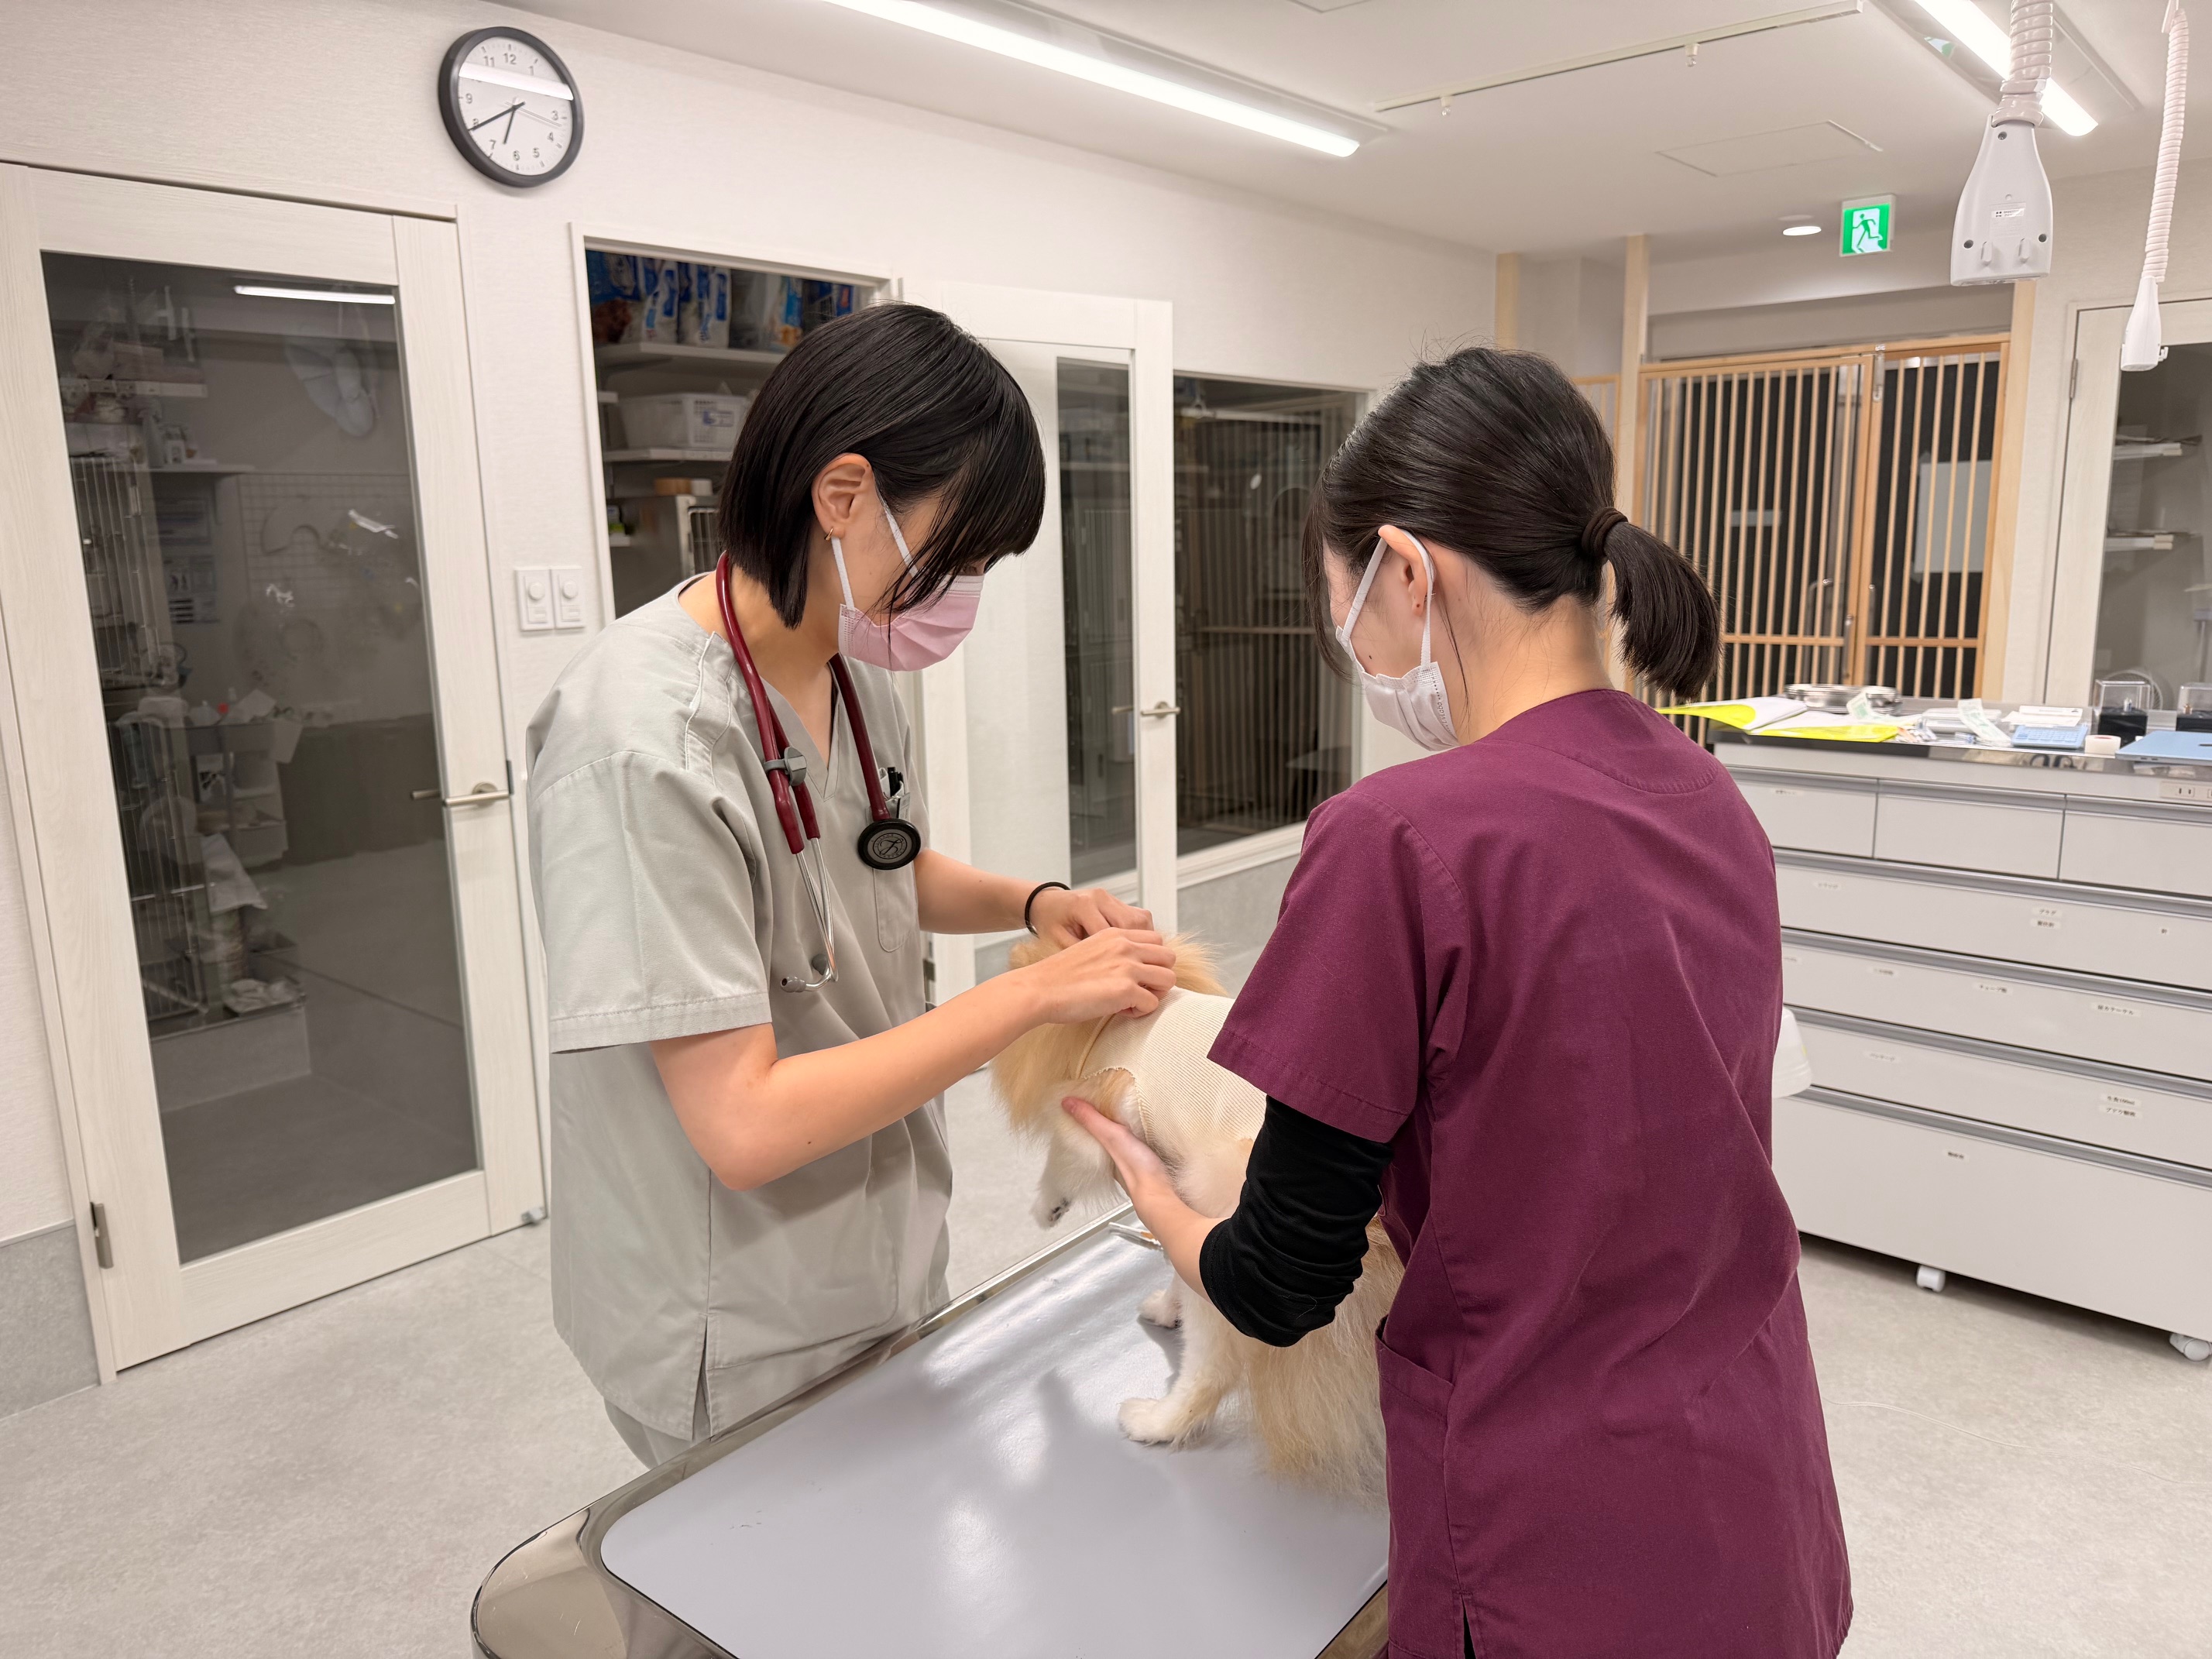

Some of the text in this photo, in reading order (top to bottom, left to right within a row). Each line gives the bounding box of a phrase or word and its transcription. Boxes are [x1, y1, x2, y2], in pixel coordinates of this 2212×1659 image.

[483, 55, 496, 67] 11
[503, 53, 517, 65] 12
[529, 65, 534, 76] 1
[465, 93, 473, 105] 9
[551, 110, 559, 121] 3
[547, 132, 555, 143] 4
[489, 139, 496, 149] 7
[513, 150, 520, 161] 6
[533, 147, 540, 159] 5
